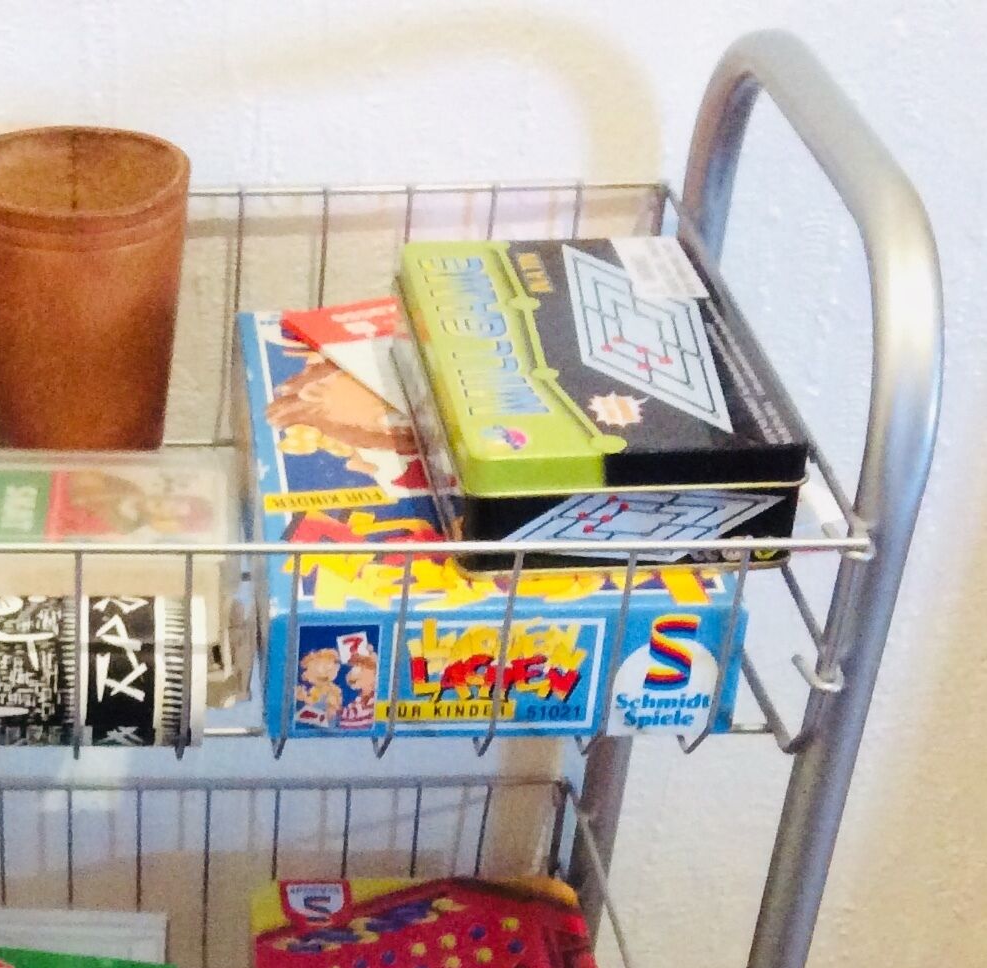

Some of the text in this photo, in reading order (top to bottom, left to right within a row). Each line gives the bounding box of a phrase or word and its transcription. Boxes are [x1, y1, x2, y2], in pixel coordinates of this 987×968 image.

[340, 633, 364, 656] 7
[645, 613, 701, 690] S
[615, 691, 714, 711] Schmidt
[527, 704, 581, 719] 51021
[624, 710, 696, 728] Spiele
